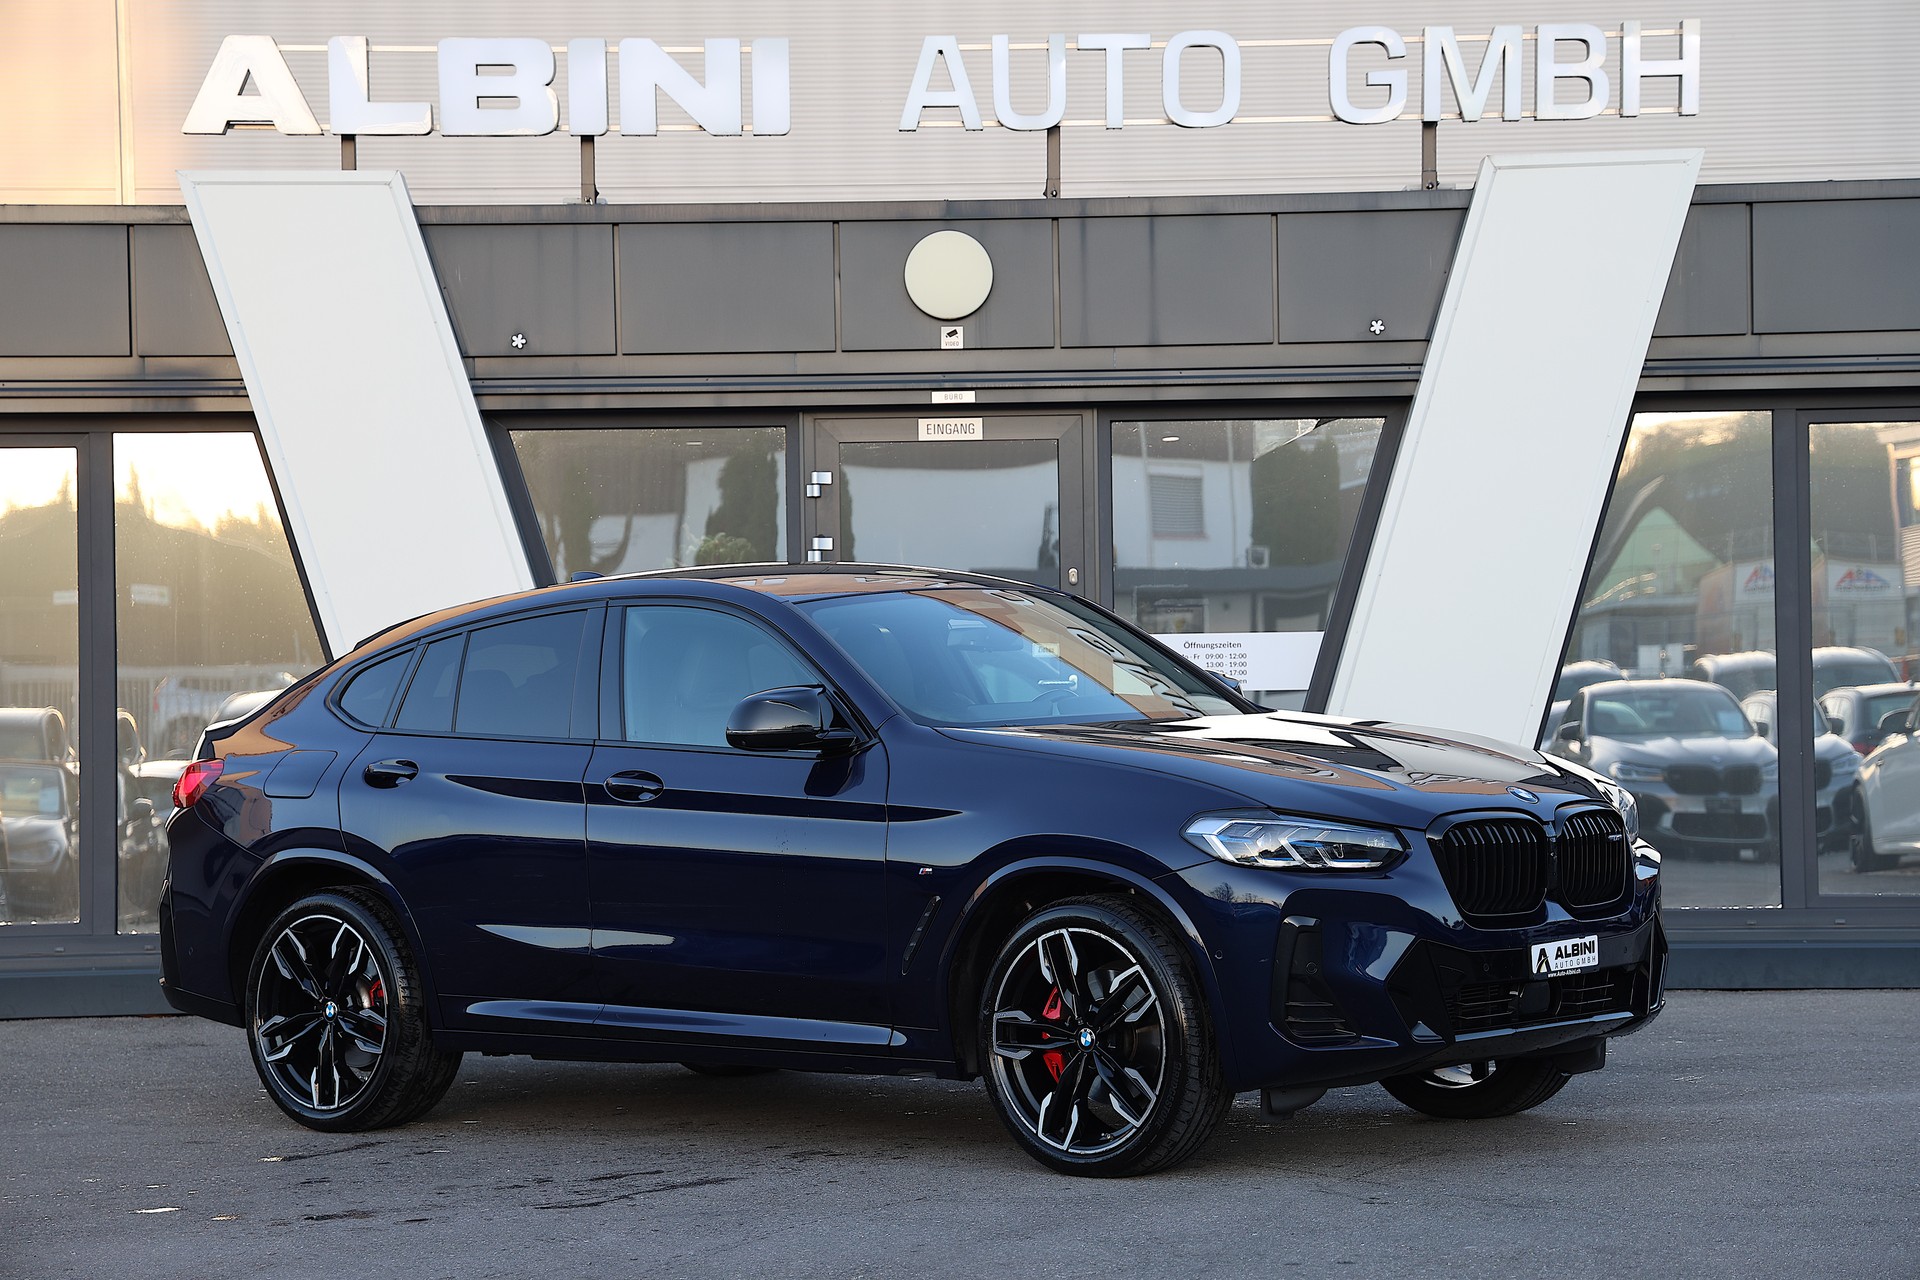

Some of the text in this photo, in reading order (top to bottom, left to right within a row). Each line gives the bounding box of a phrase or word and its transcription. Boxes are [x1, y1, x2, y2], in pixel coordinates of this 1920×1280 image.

[181, 18, 1702, 137] ALBINI AUTO GMBH
[926, 422, 975, 435] EINGANG
[1183, 640, 1242, 650] Öffnungszeiten
[1554, 940, 1596, 961] ALBINI
[1554, 959, 1574, 970] AUTO
